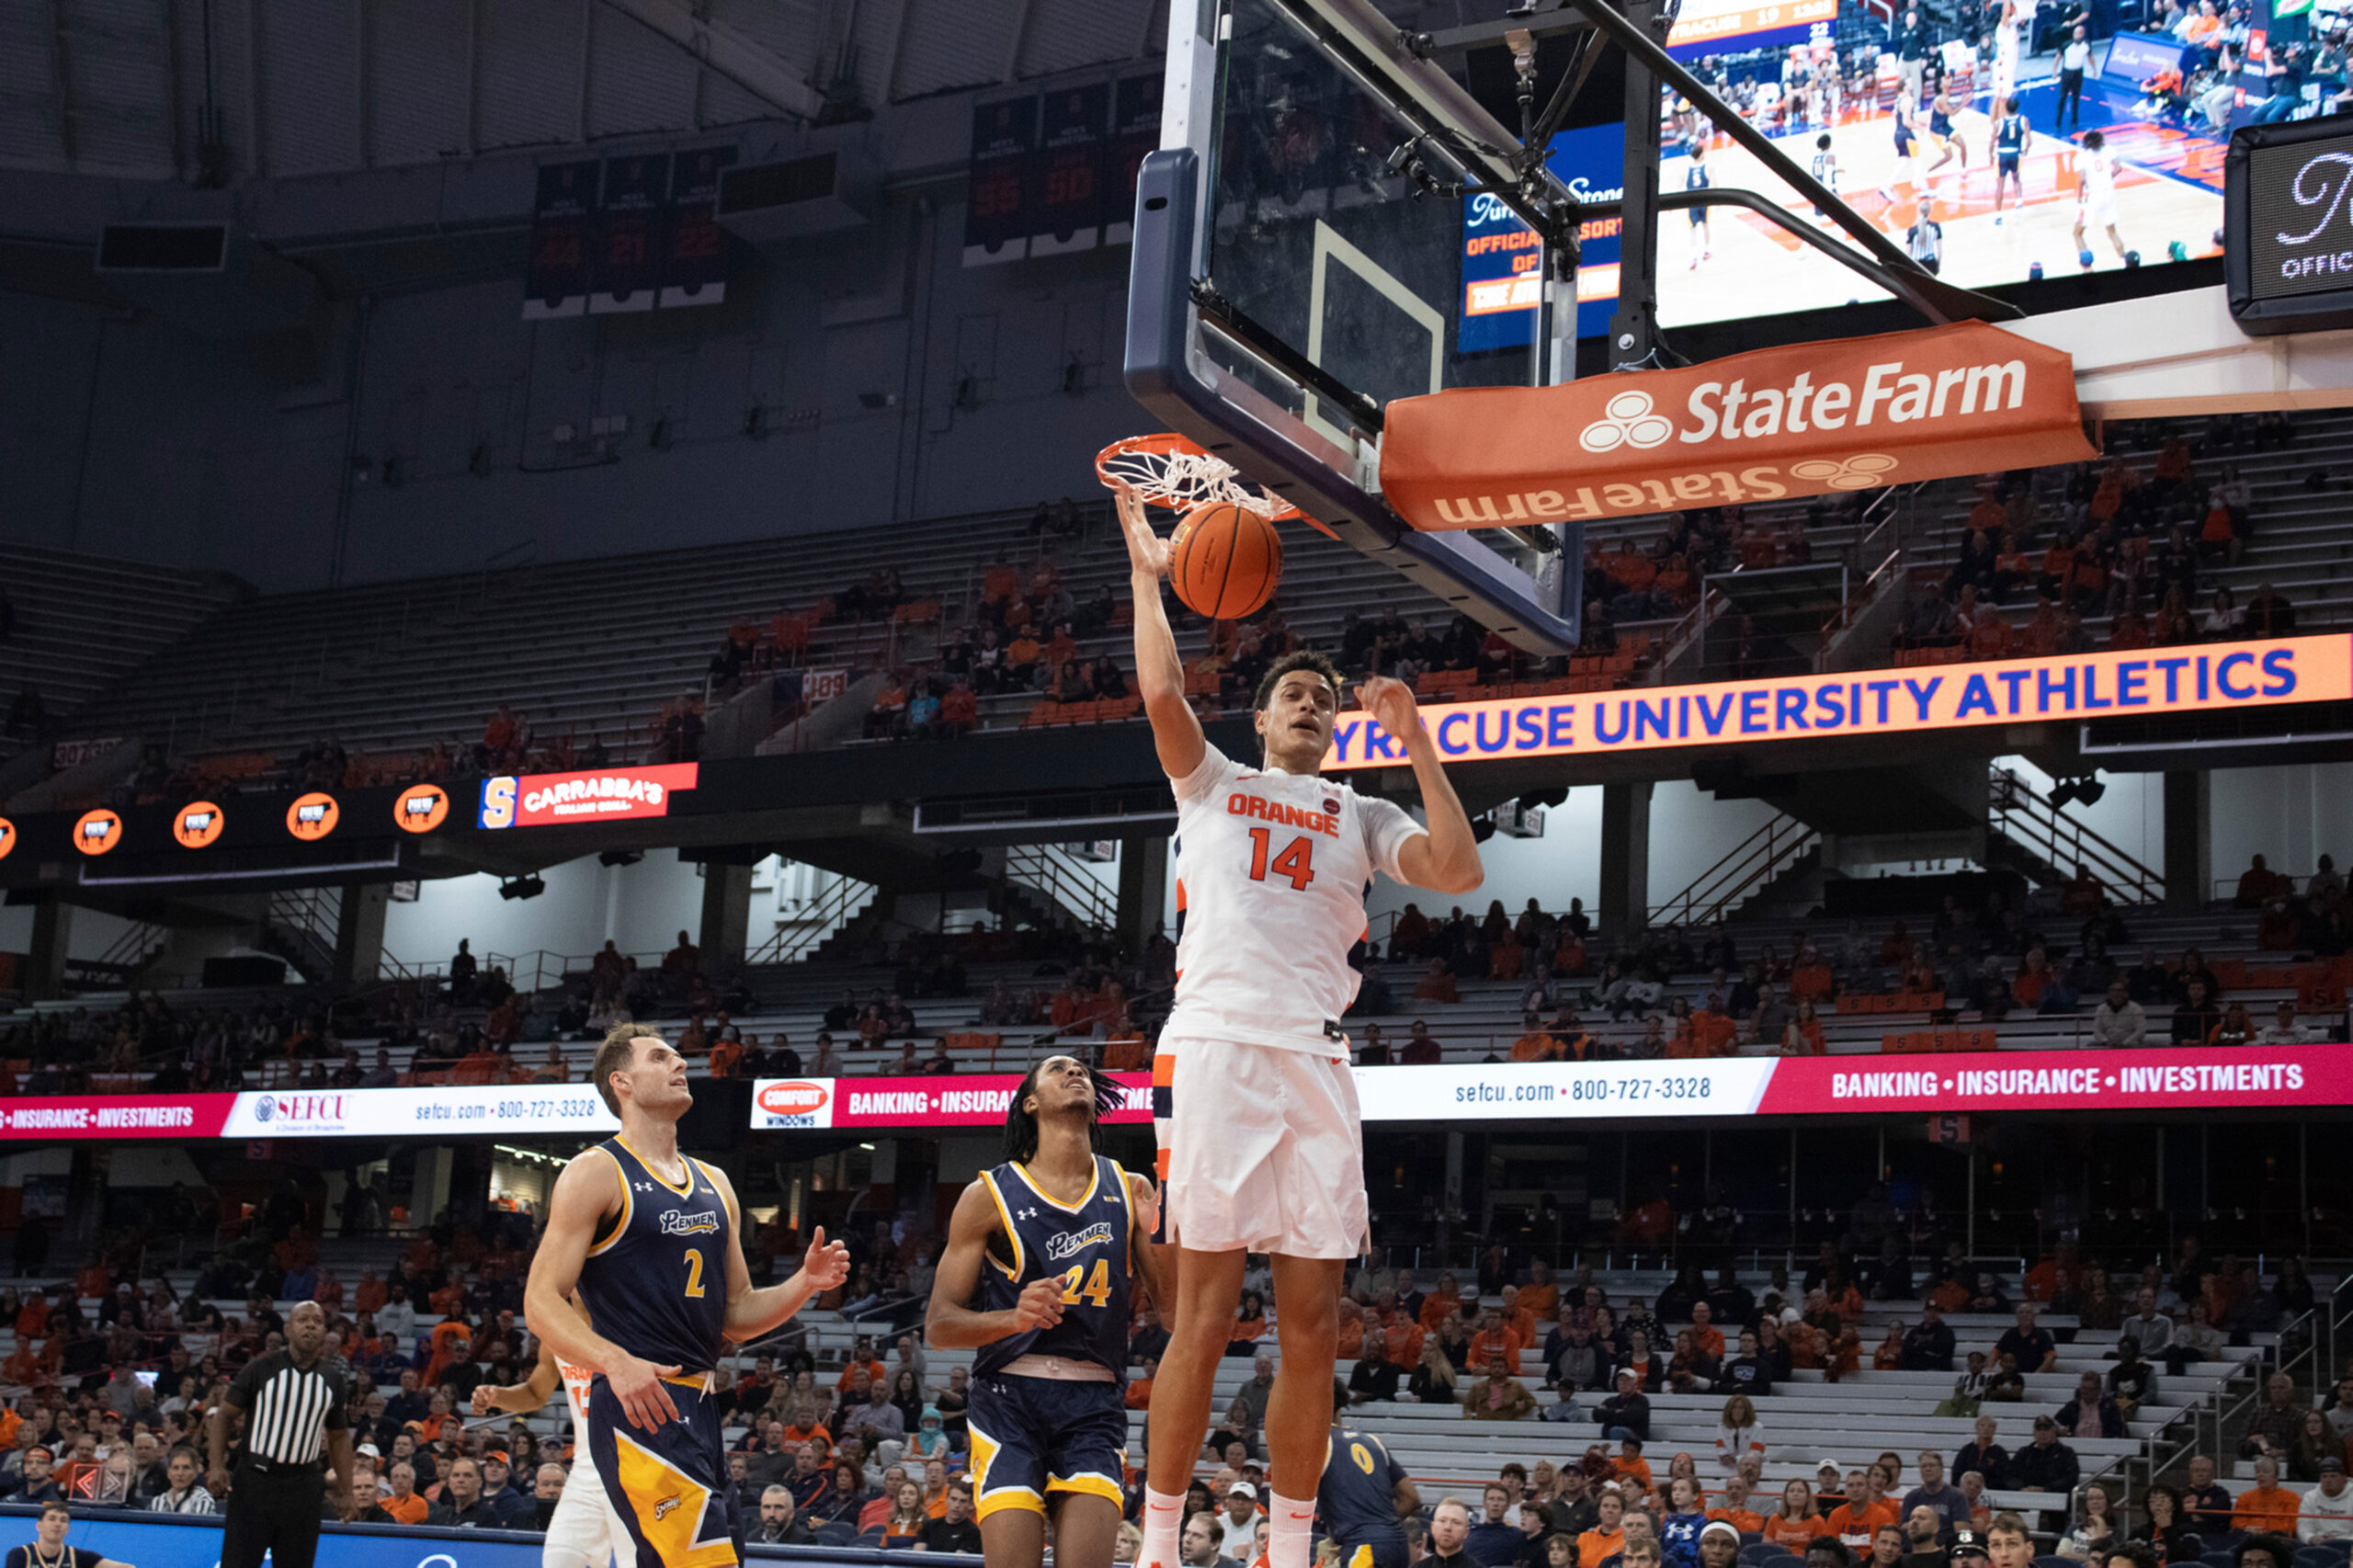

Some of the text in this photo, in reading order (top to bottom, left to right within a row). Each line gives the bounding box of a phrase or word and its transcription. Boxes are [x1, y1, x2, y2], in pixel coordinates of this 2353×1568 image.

[1669, 14, 1742, 39] YRACUSE
[1466, 230, 1542, 257] OFFICIA
[1512, 254, 1539, 274] OF
[2280, 251, 2353, 279] OFFIC
[1595, 676, 1944, 744] UNIVERSITY
[1954, 649, 2297, 720] ATHLETICS
[483, 776, 517, 829] S
[524, 778, 664, 812] CARRABBA'S
[1228, 793, 1339, 839] ORANGE
[1248, 827, 1315, 892] 14
[1455, 1077, 1711, 1102] sefcu.com 800-727-3328
[1832, 1063, 2304, 1097] BANKING INSURANCE INVESTMENTS
[277, 1095, 347, 1122] SEFCU
[415, 1098, 596, 1120] sefcu.com 800-727-3328
[764, 1088, 821, 1107] COMFORT
[848, 1089, 1012, 1115] BANKING INSURA
[12, 1108, 89, 1130] INSURANCE
[97, 1106, 194, 1128] INVESTMENTS
[766, 1115, 815, 1127] WINDOWS
[683, 1248, 706, 1299] 2
[1058, 1258, 1112, 1308] 24
[1350, 1442, 1375, 1475] 0
